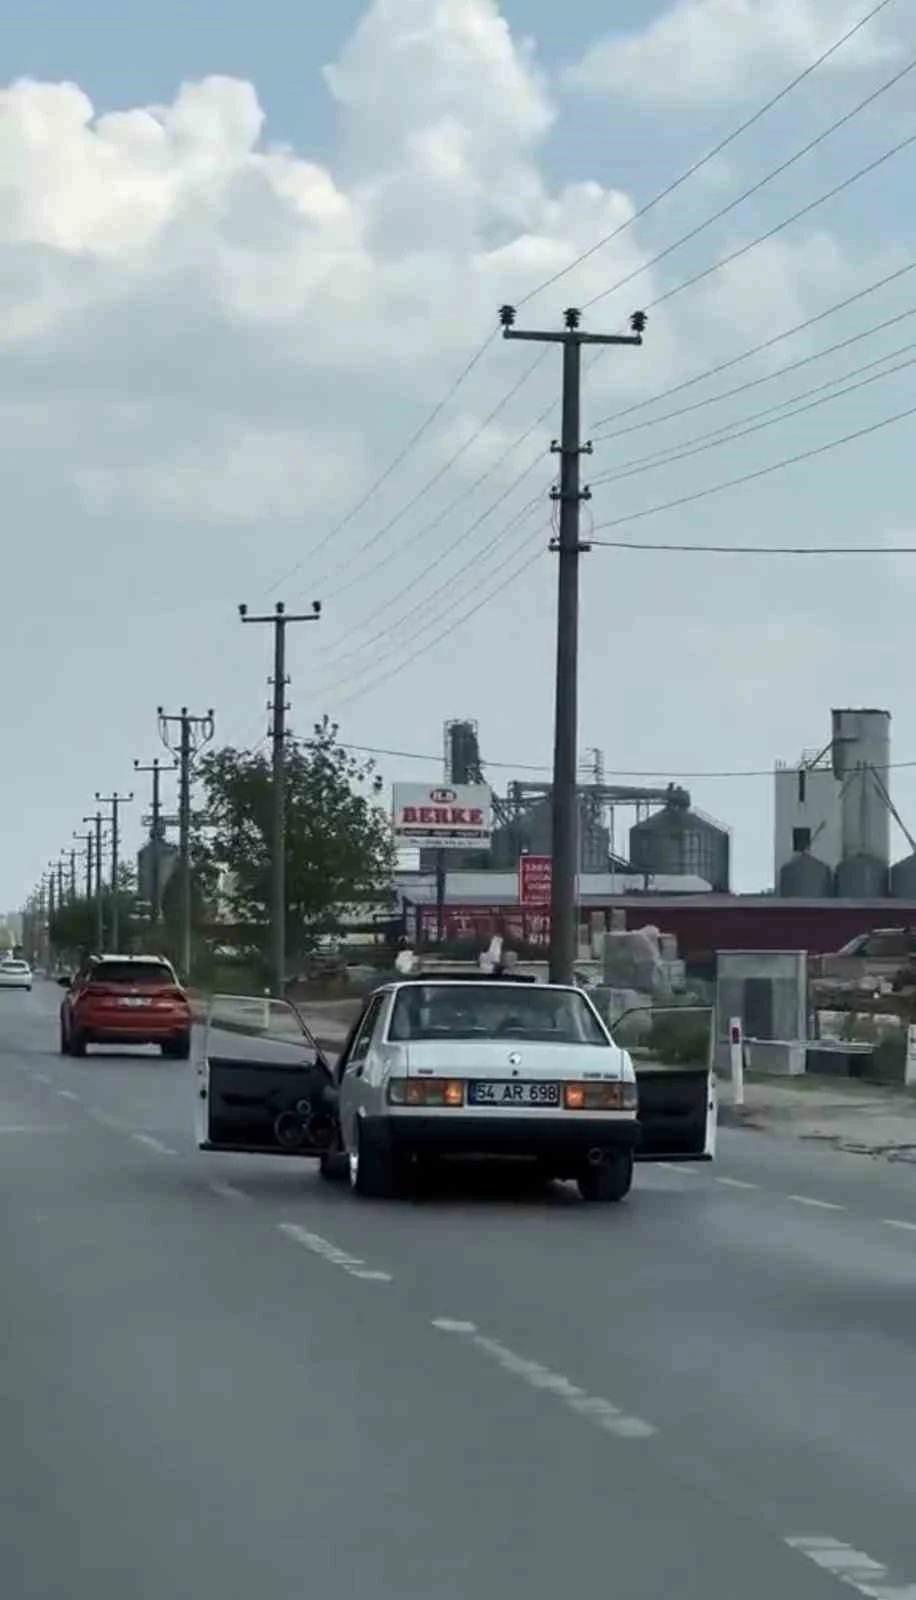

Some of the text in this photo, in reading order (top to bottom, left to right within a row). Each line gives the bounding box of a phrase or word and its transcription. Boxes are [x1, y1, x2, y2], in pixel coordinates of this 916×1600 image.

[402, 807, 483, 825] BERKE
[477, 1084, 557, 1101] 54 AR 698
